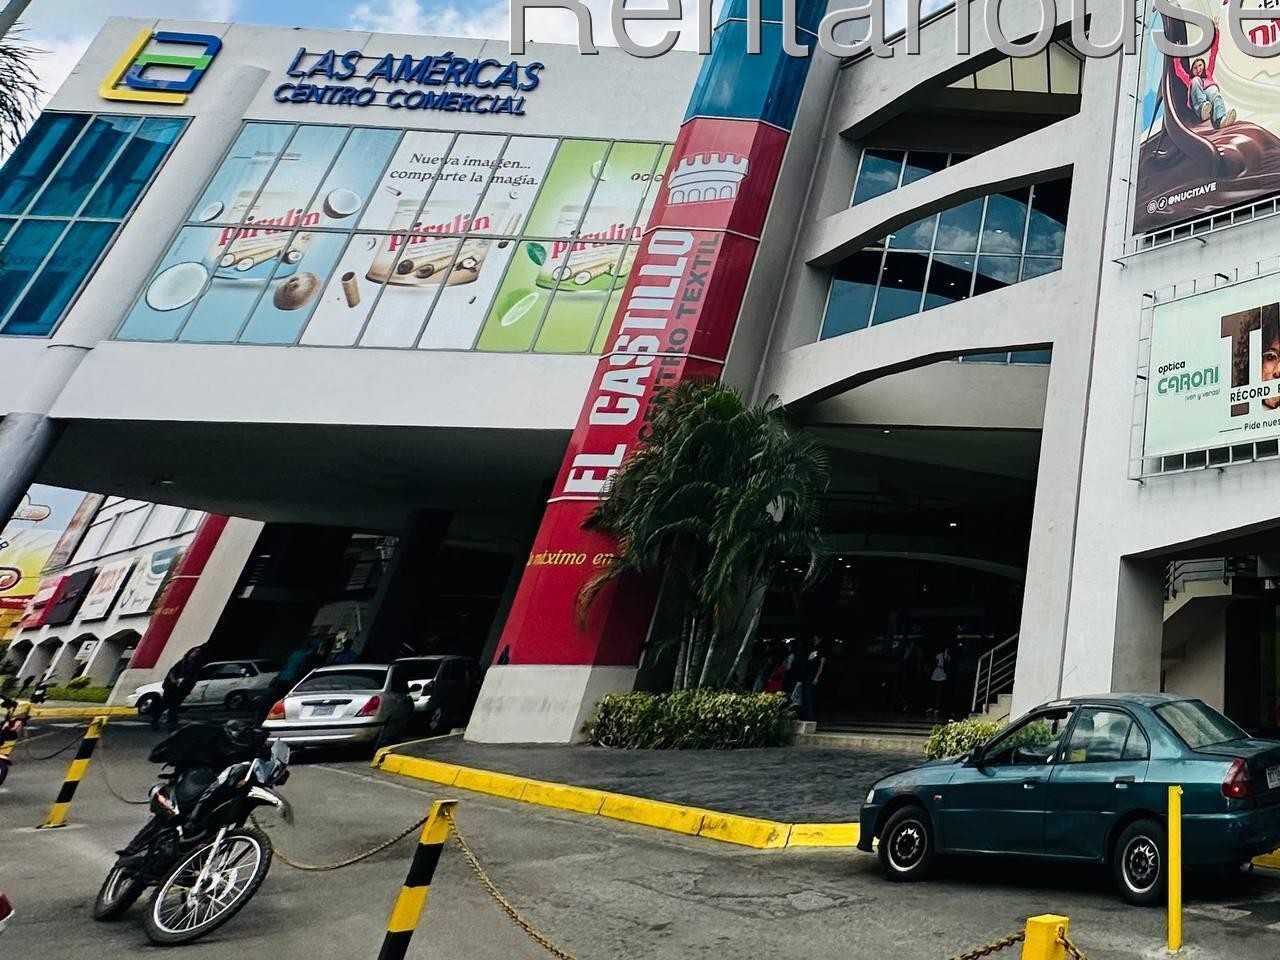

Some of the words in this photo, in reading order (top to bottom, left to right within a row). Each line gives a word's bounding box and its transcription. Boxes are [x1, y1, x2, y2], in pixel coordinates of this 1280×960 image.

[286, 47, 362, 81] LAS
[365, 51, 545, 91] AMÉRICAS
[273, 83, 377, 107] CENTRO
[386, 89, 526, 115] COMERCIAL
[470, 172, 483, 183] la
[1168, 182, 1217, 205] @NUCITAVE
[675, 233, 720, 320] TEXTIL
[589, 230, 694, 426] CASTILLO
[1158, 361, 1186, 375] optica
[1230, 385, 1271, 403] RÉCORD
[1244, 421, 1261, 431] Pide
[564, 444, 627, 493] EL
